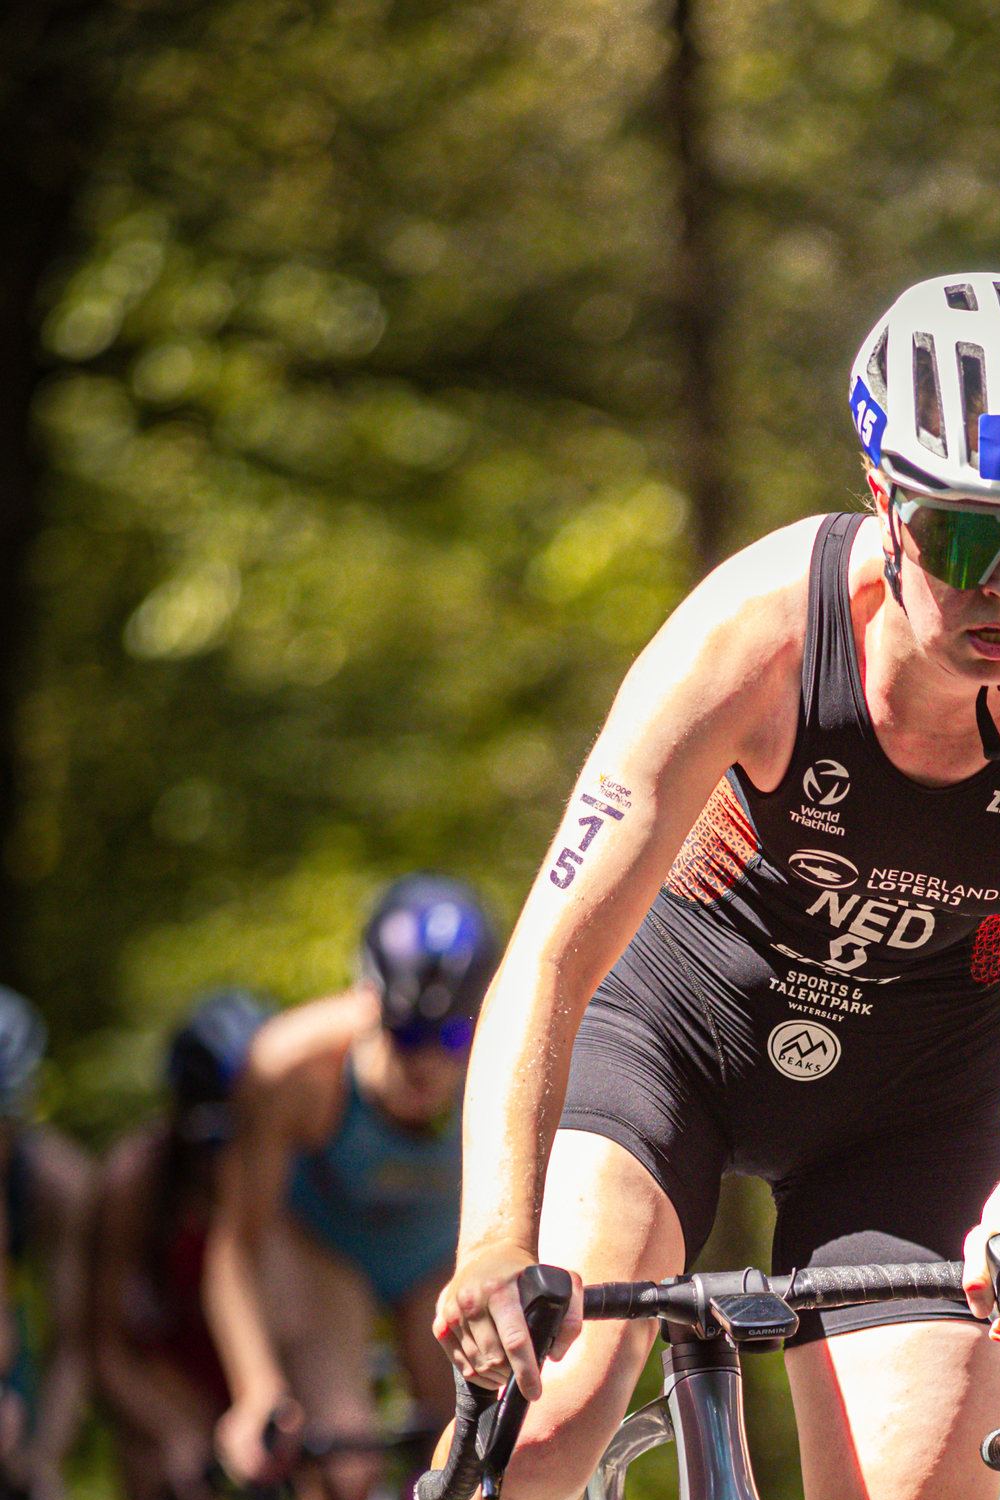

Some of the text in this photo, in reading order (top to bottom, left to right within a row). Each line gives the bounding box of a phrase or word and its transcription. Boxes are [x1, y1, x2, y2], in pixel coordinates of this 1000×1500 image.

[856, 400, 878, 447] 15
[789, 811, 846, 837] Triathlon
[800, 804, 840, 823] World
[866, 879, 962, 906] LOTERIJ
[805, 889, 936, 950] NED
[768, 977, 874, 1016] TALENTPARK
[786, 970, 864, 1001] SPORTS &
[787, 1001, 845, 1023] WATERSLEY
[779, 1053, 822, 1073] PEAKS
[748, 1327, 786, 1336] GARMIN
